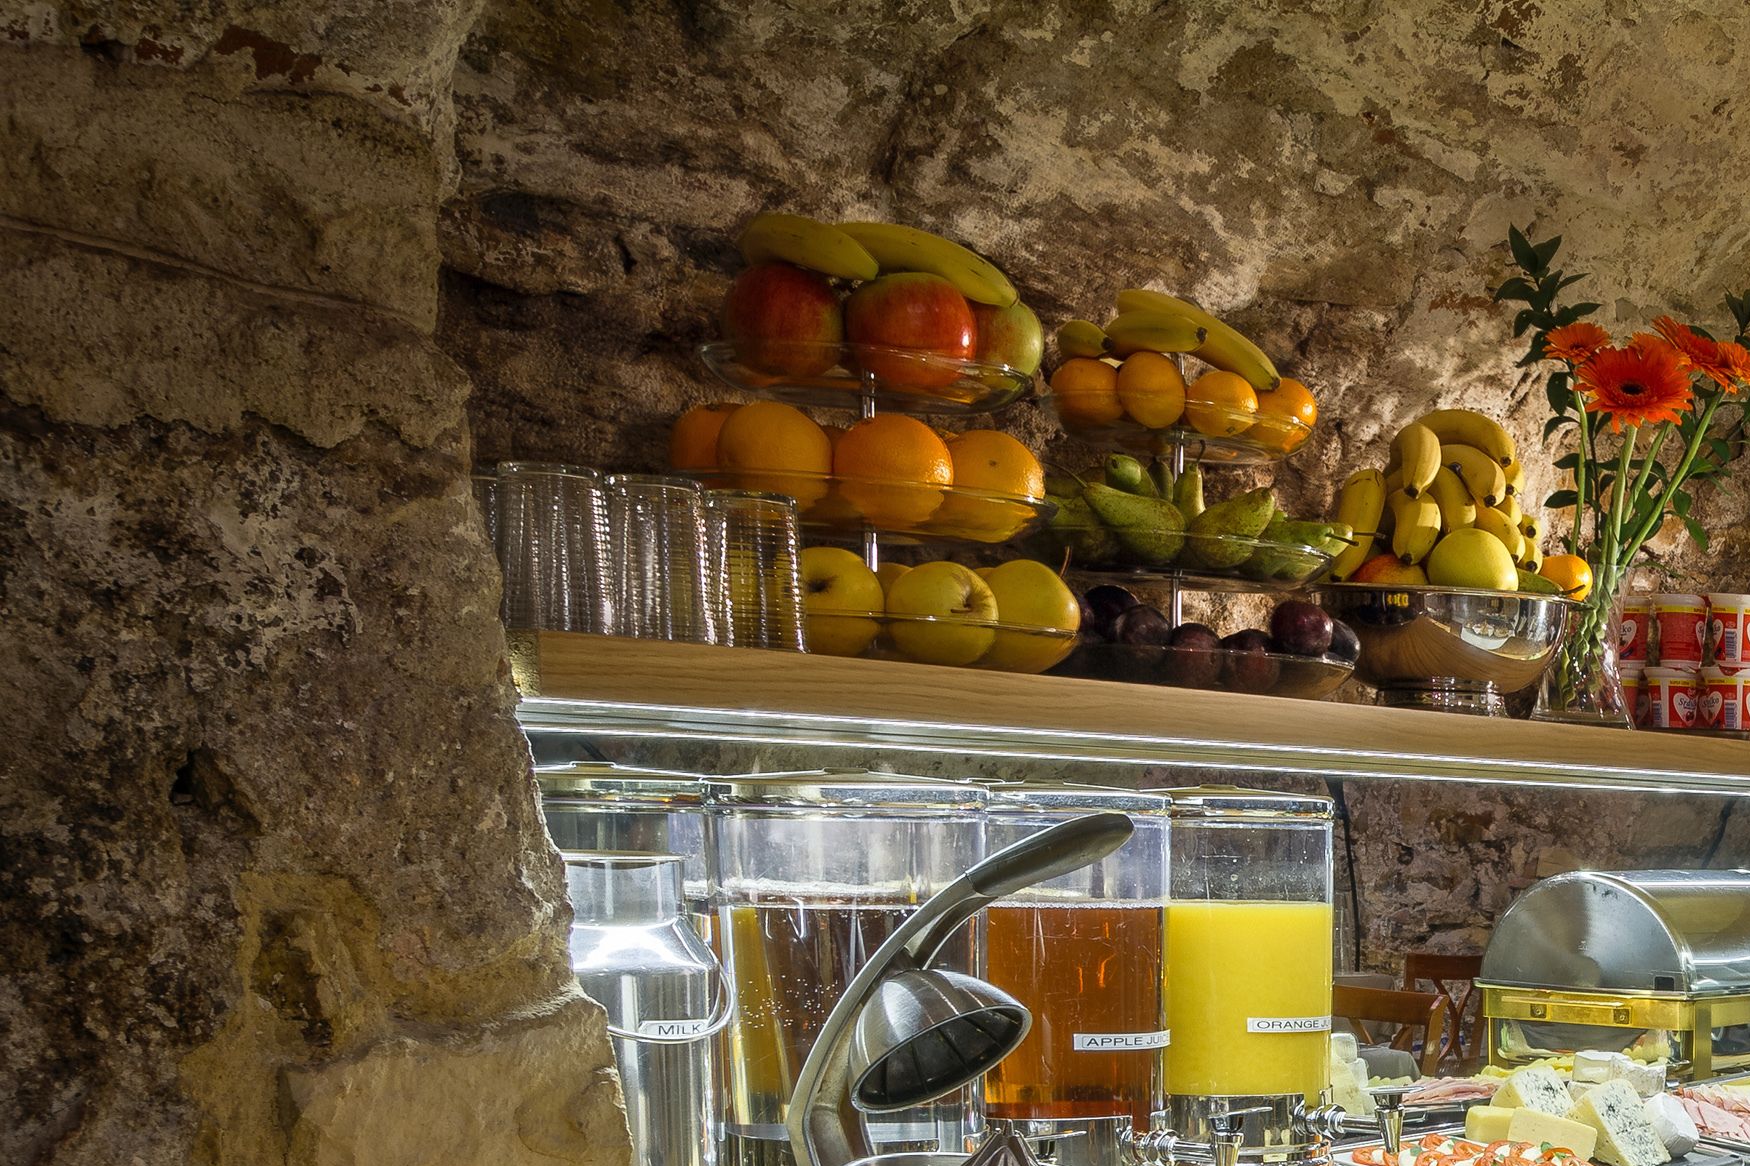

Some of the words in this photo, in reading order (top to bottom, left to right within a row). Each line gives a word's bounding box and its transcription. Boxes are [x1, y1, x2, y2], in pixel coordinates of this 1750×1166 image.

[658, 1024, 701, 1036] MILK
[1256, 1019, 1320, 1030] ORANGE
[1086, 1036, 1143, 1047] APPLE
